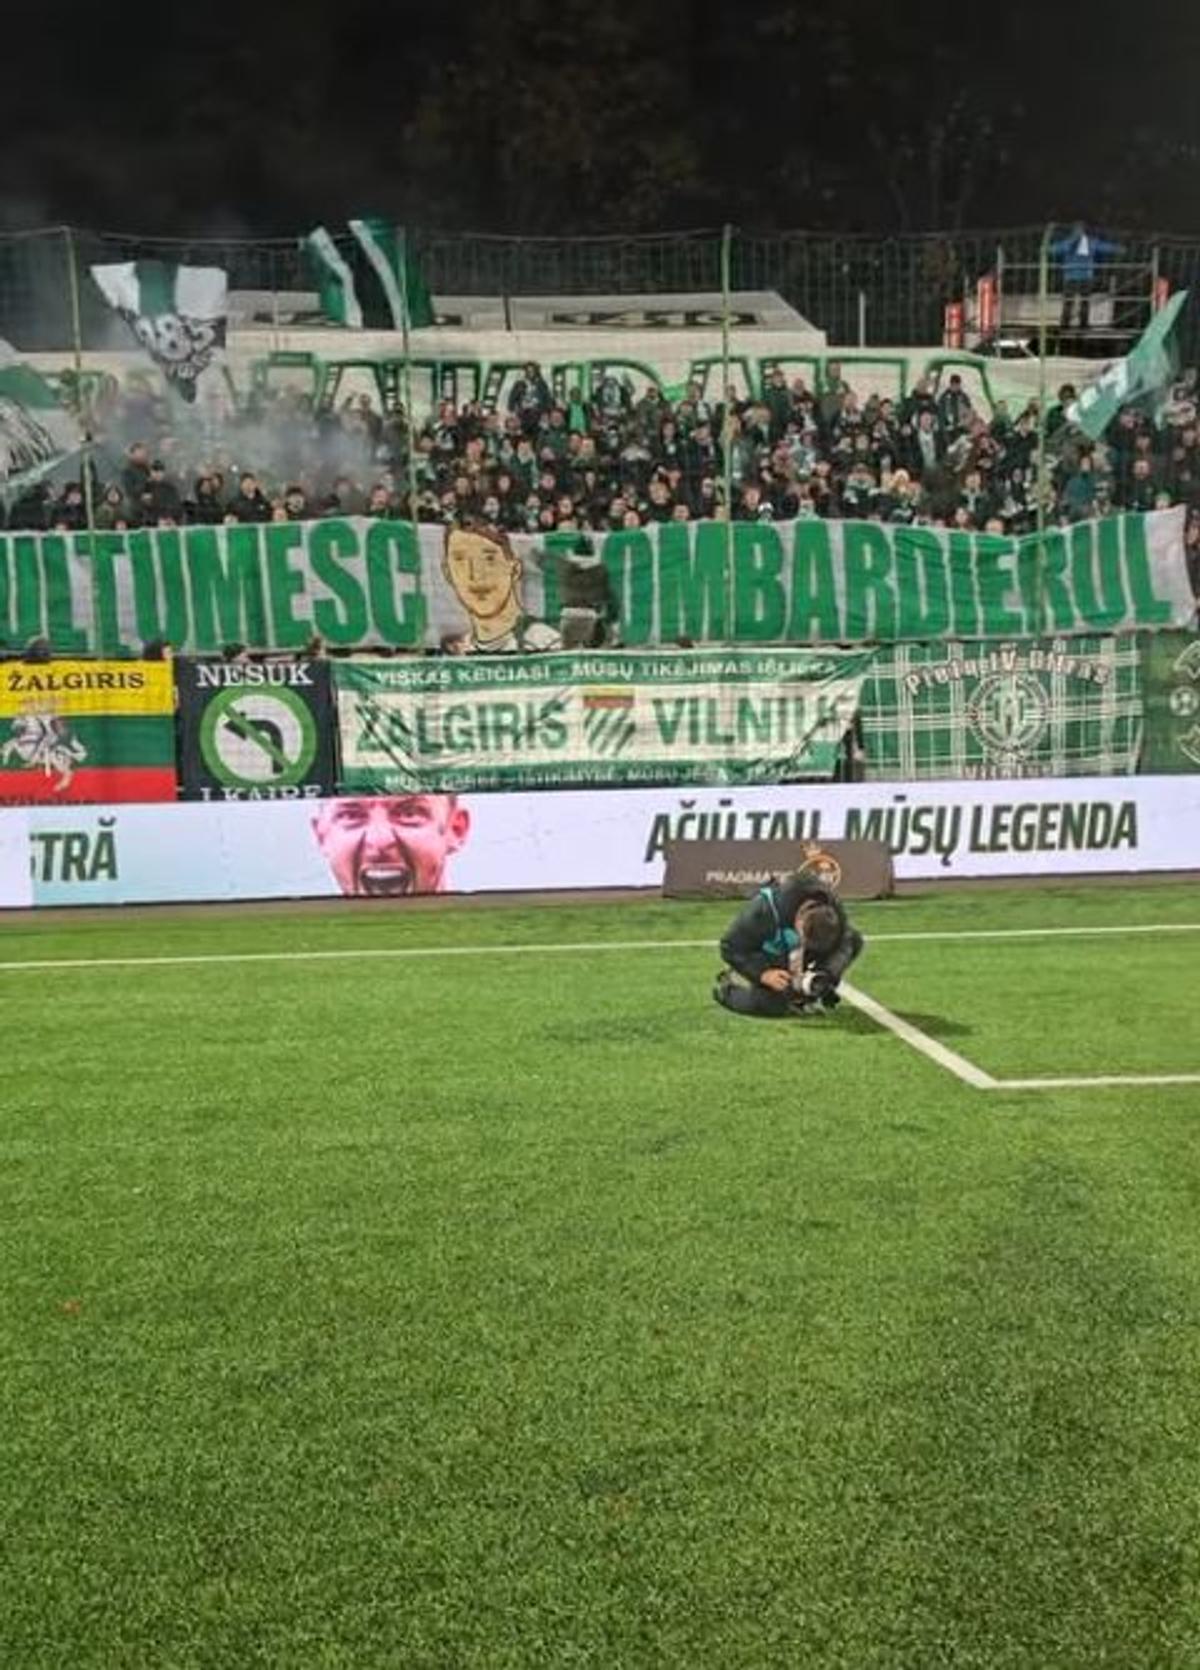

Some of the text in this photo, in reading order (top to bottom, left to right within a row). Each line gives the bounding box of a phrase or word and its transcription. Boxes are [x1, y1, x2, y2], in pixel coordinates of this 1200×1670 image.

[8, 669, 145, 692] ŽALGIRIS
[196, 662, 313, 687] NESUK
[844, 794, 961, 867] MŪSŲ
[969, 801, 1137, 853] LEGENDA
